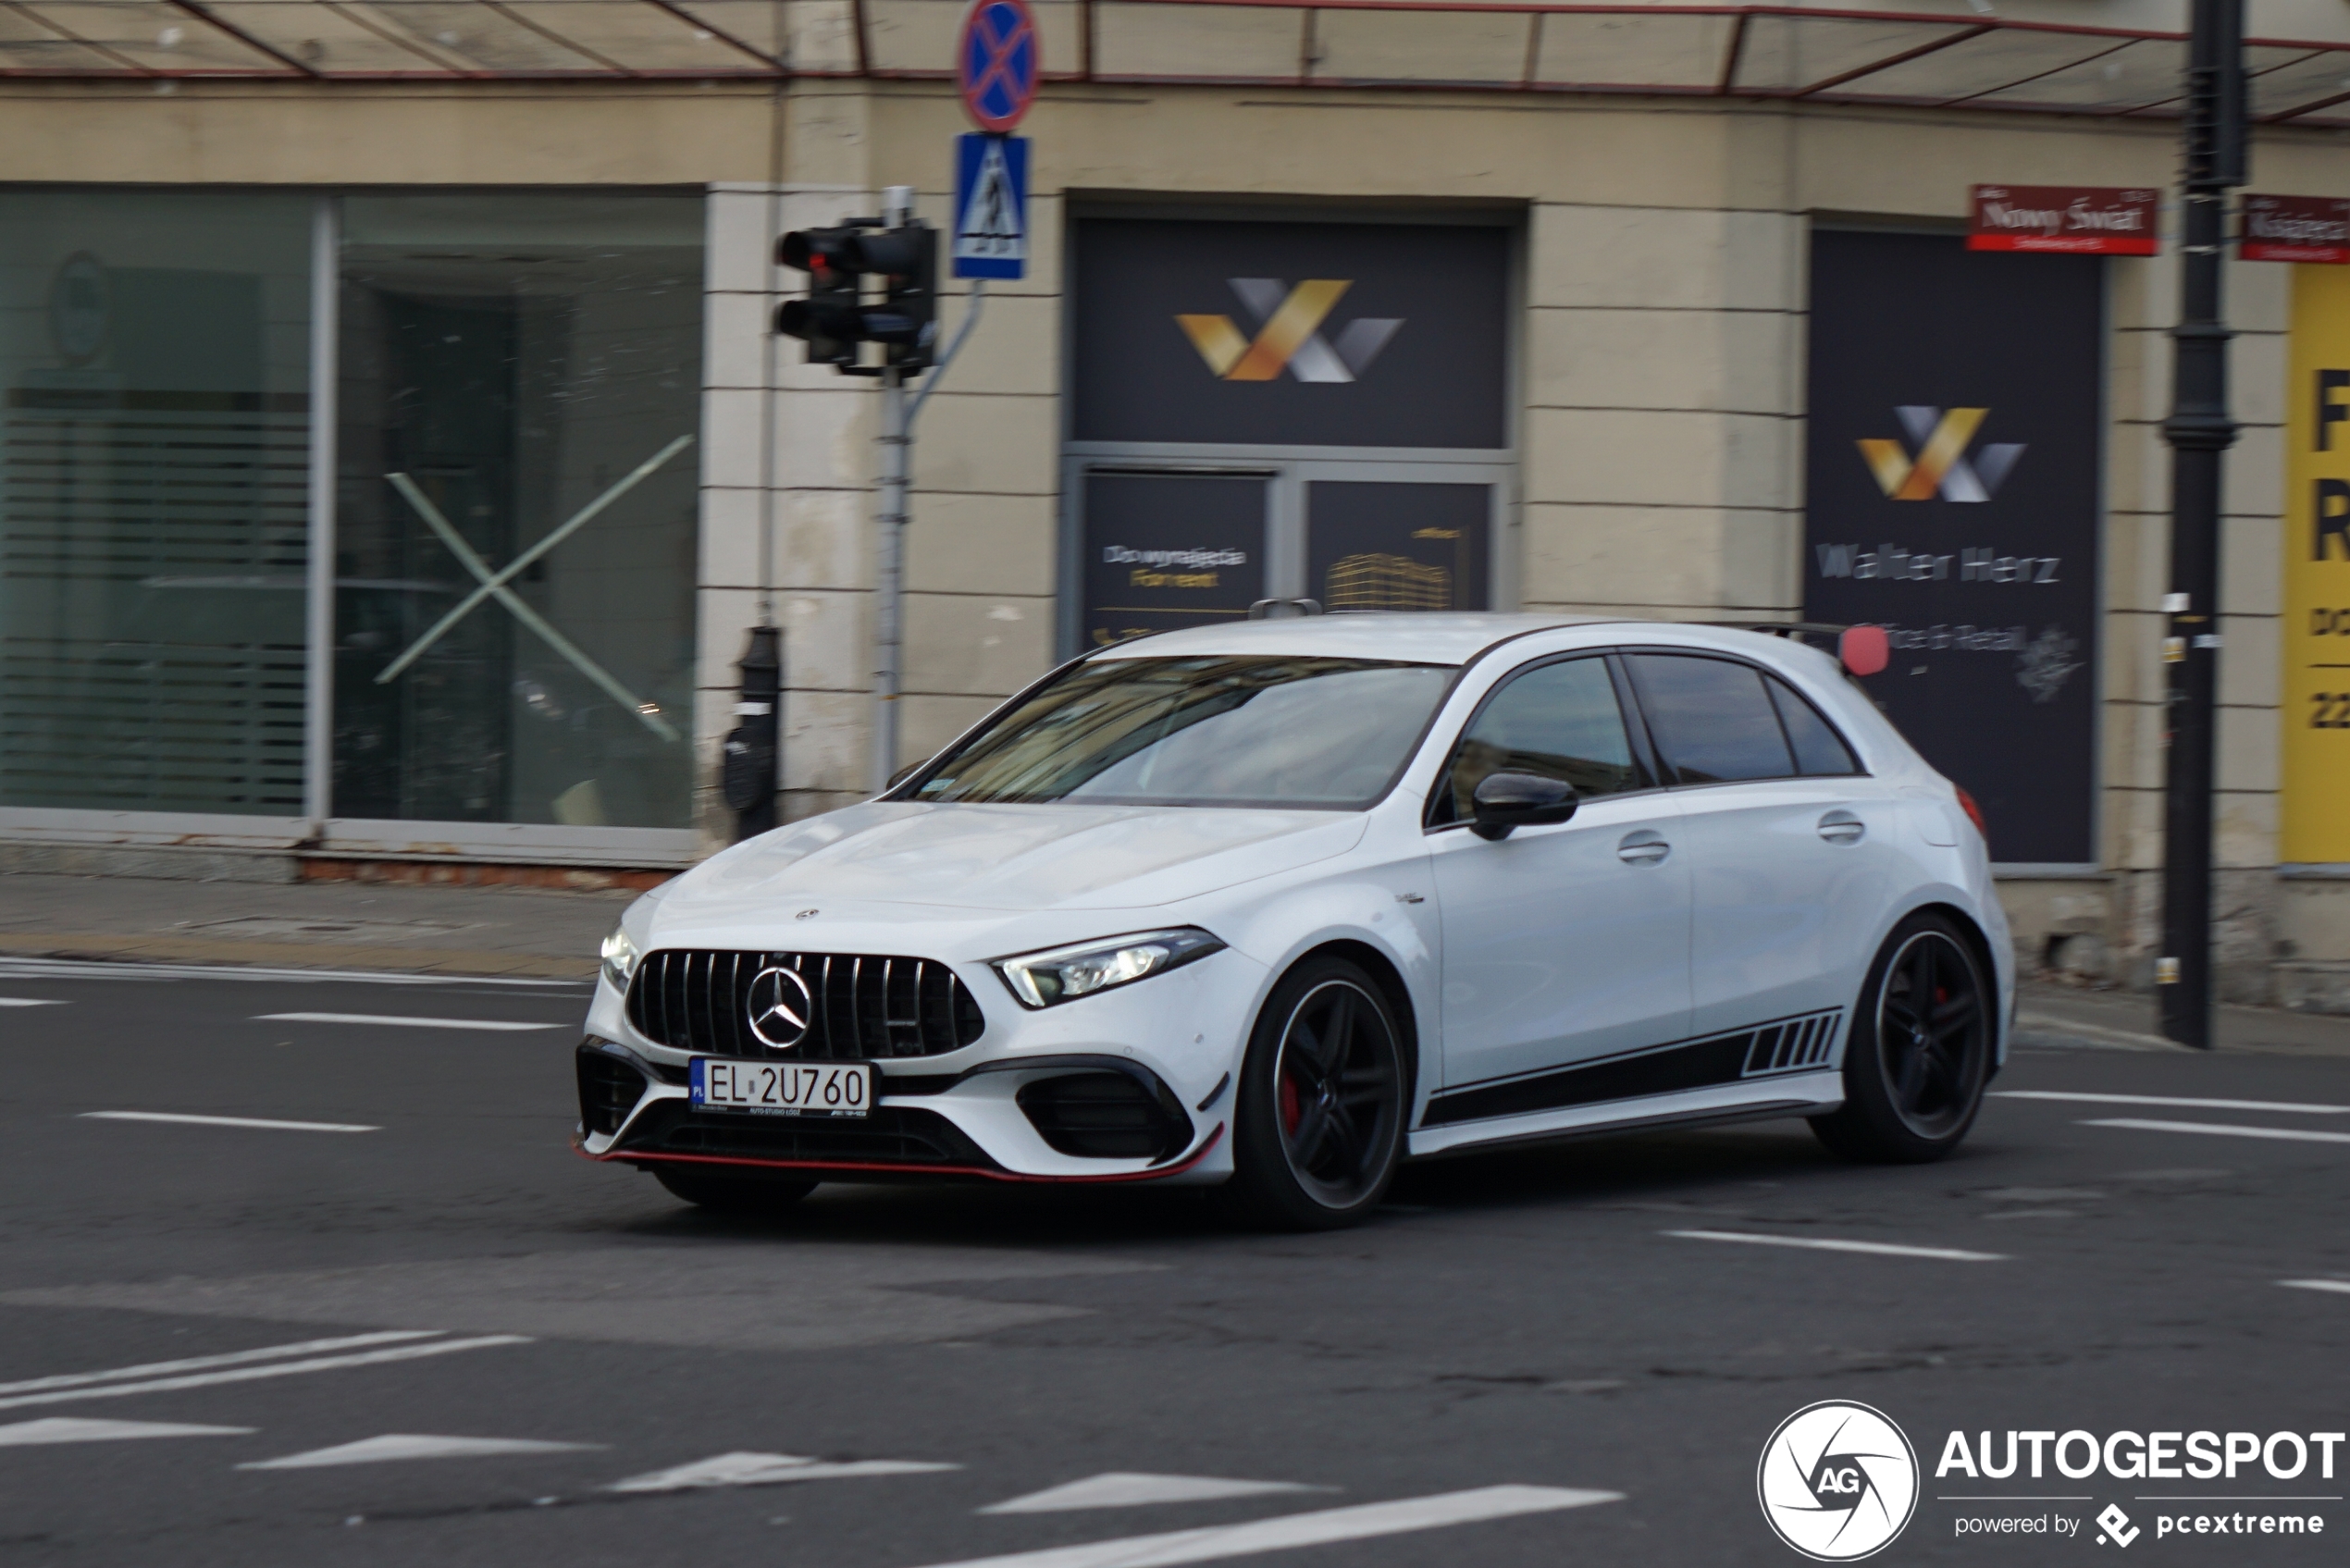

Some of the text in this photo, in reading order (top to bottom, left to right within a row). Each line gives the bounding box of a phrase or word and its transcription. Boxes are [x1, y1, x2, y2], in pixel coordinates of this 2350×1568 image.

[1983, 196, 2144, 238] Nowy Świat
[1815, 542, 2062, 584] Walter Herz
[693, 1086, 704, 1098] PL
[711, 1065, 862, 1105] EL 2U760
